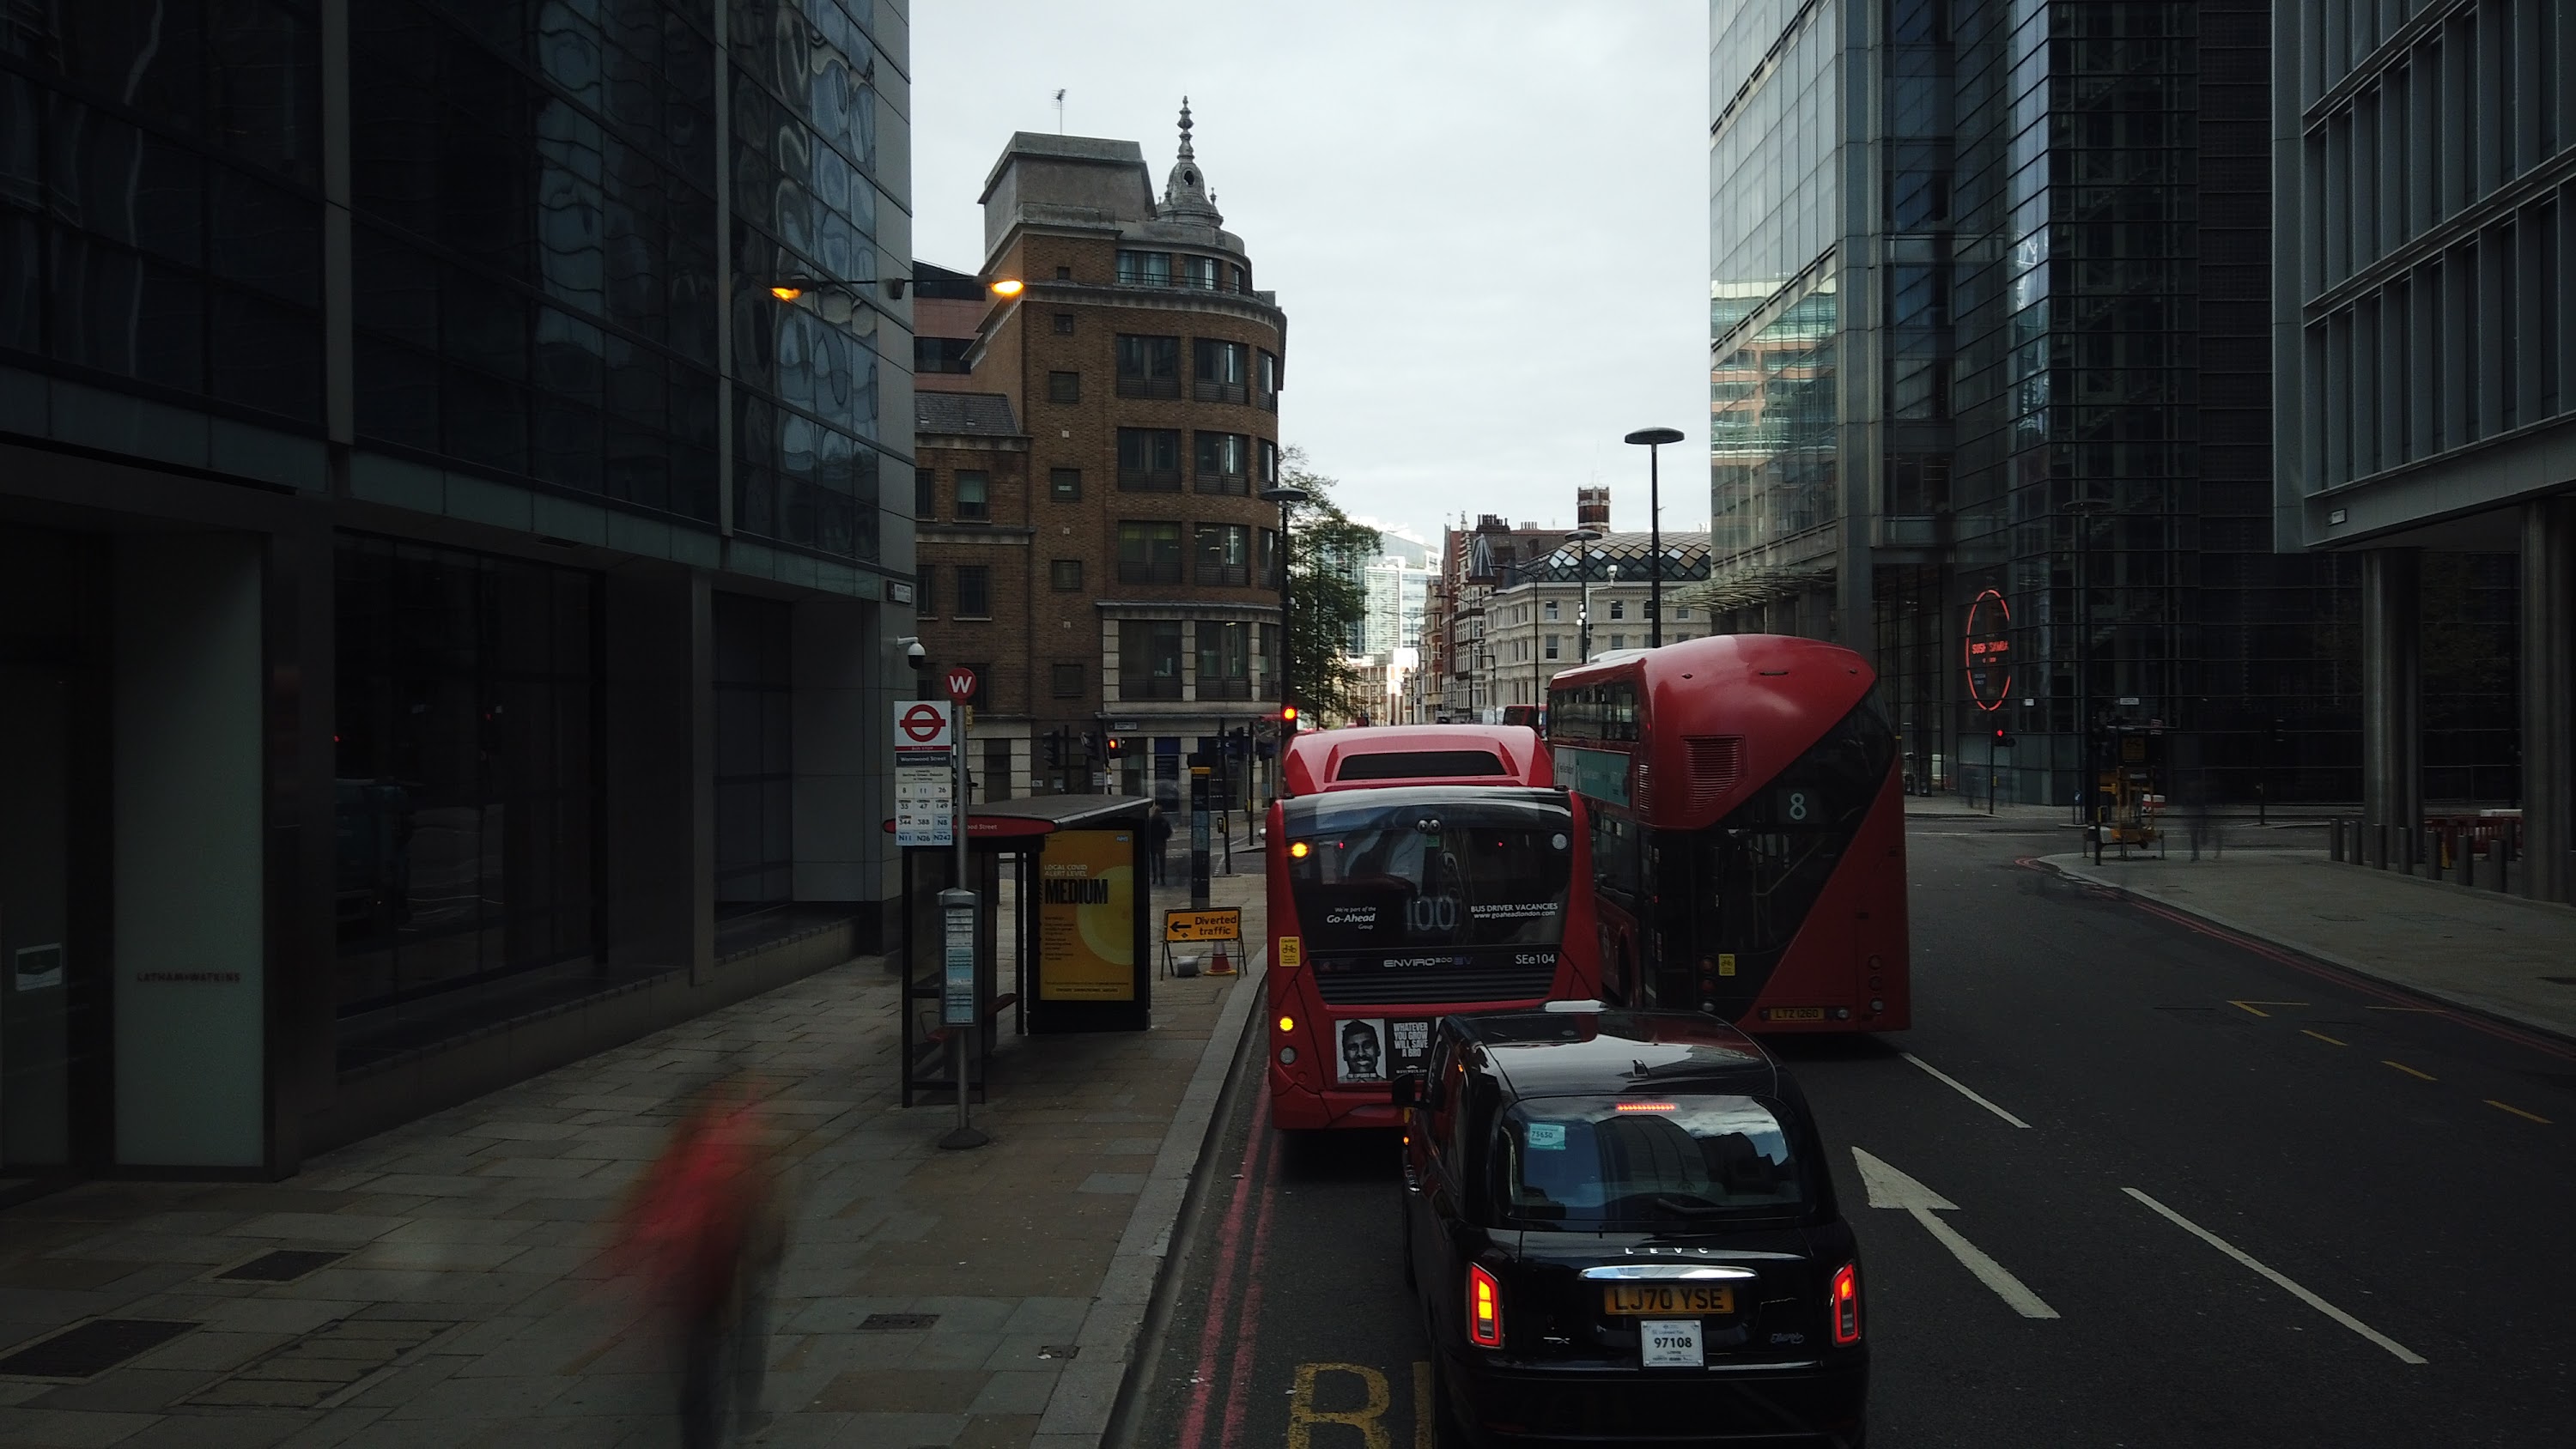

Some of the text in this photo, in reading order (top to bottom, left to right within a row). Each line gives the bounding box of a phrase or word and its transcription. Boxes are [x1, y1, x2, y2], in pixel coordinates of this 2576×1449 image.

[949, 675, 972, 694] W
[1789, 792, 1807, 820] 8
[1045, 878, 1108, 904] MEDIUM
[1515, 902, 1558, 911] VACANCIES
[1326, 913, 1376, 923] Go-Ahead
[1406, 896, 1455, 931] 100
[1194, 915, 1236, 925] Diverted
[1200, 926, 1230, 936] traffic
[1515, 954, 1555, 965] SEe104
[1393, 1022, 1428, 1032] WHATEVER
[1408, 1031, 1428, 1040] GROW
[1394, 1040, 1429, 1049] WILL SAVE
[1401, 1048, 1422, 1058] A BRO
[1614, 1288, 1724, 1310] LJ70 YSE
[1654, 1337, 1692, 1348] 97108
